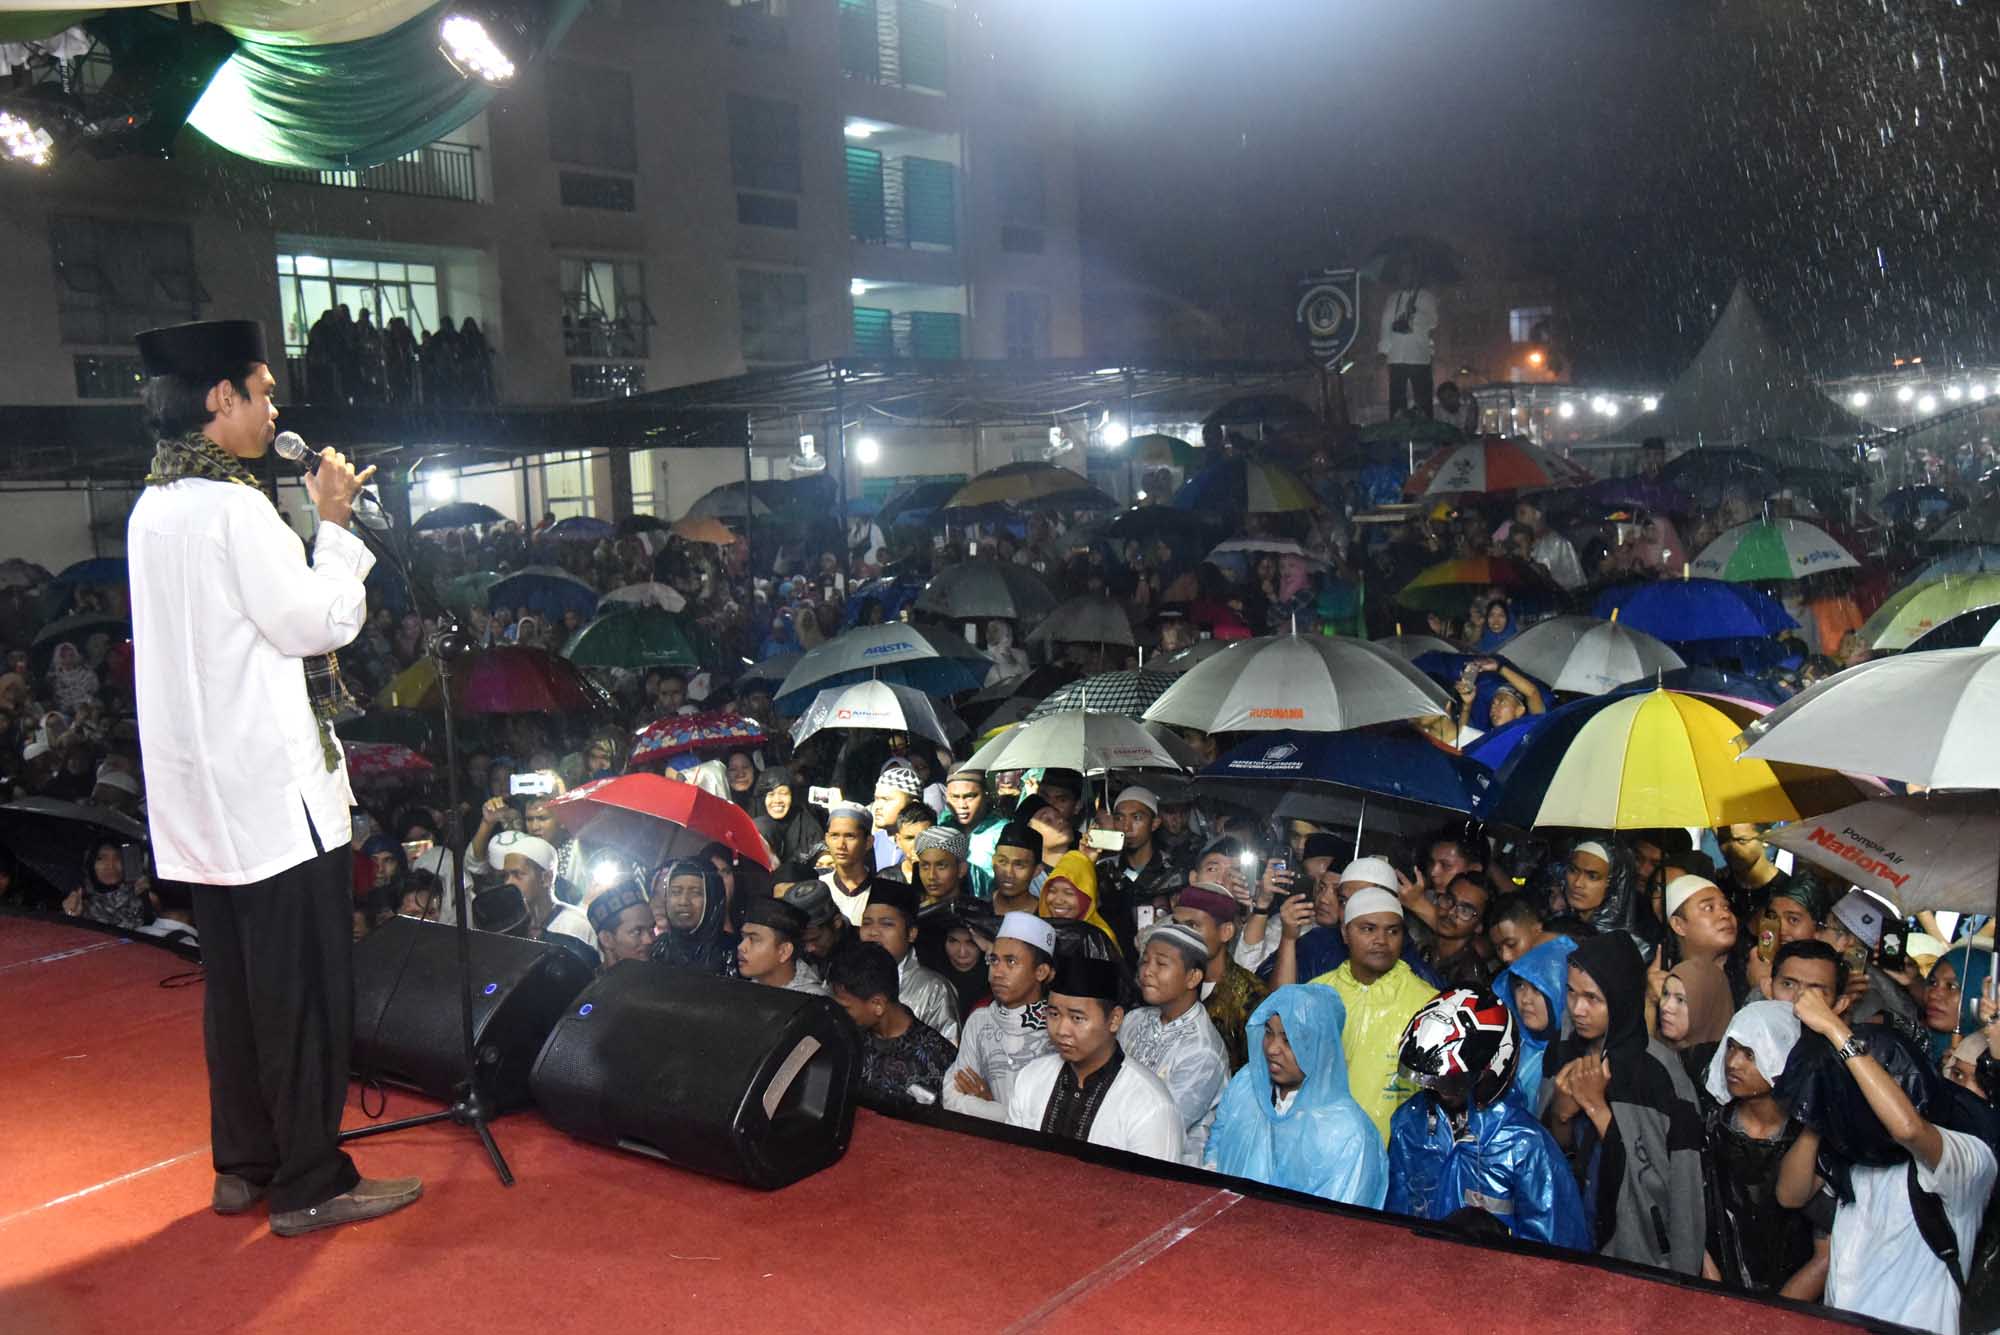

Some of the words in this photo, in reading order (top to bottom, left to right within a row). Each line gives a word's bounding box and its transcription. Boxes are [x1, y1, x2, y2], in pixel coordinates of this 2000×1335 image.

[1807, 826, 1911, 888] National
[1842, 827, 1885, 853] Pompa
[1884, 851, 1905, 865] Air
